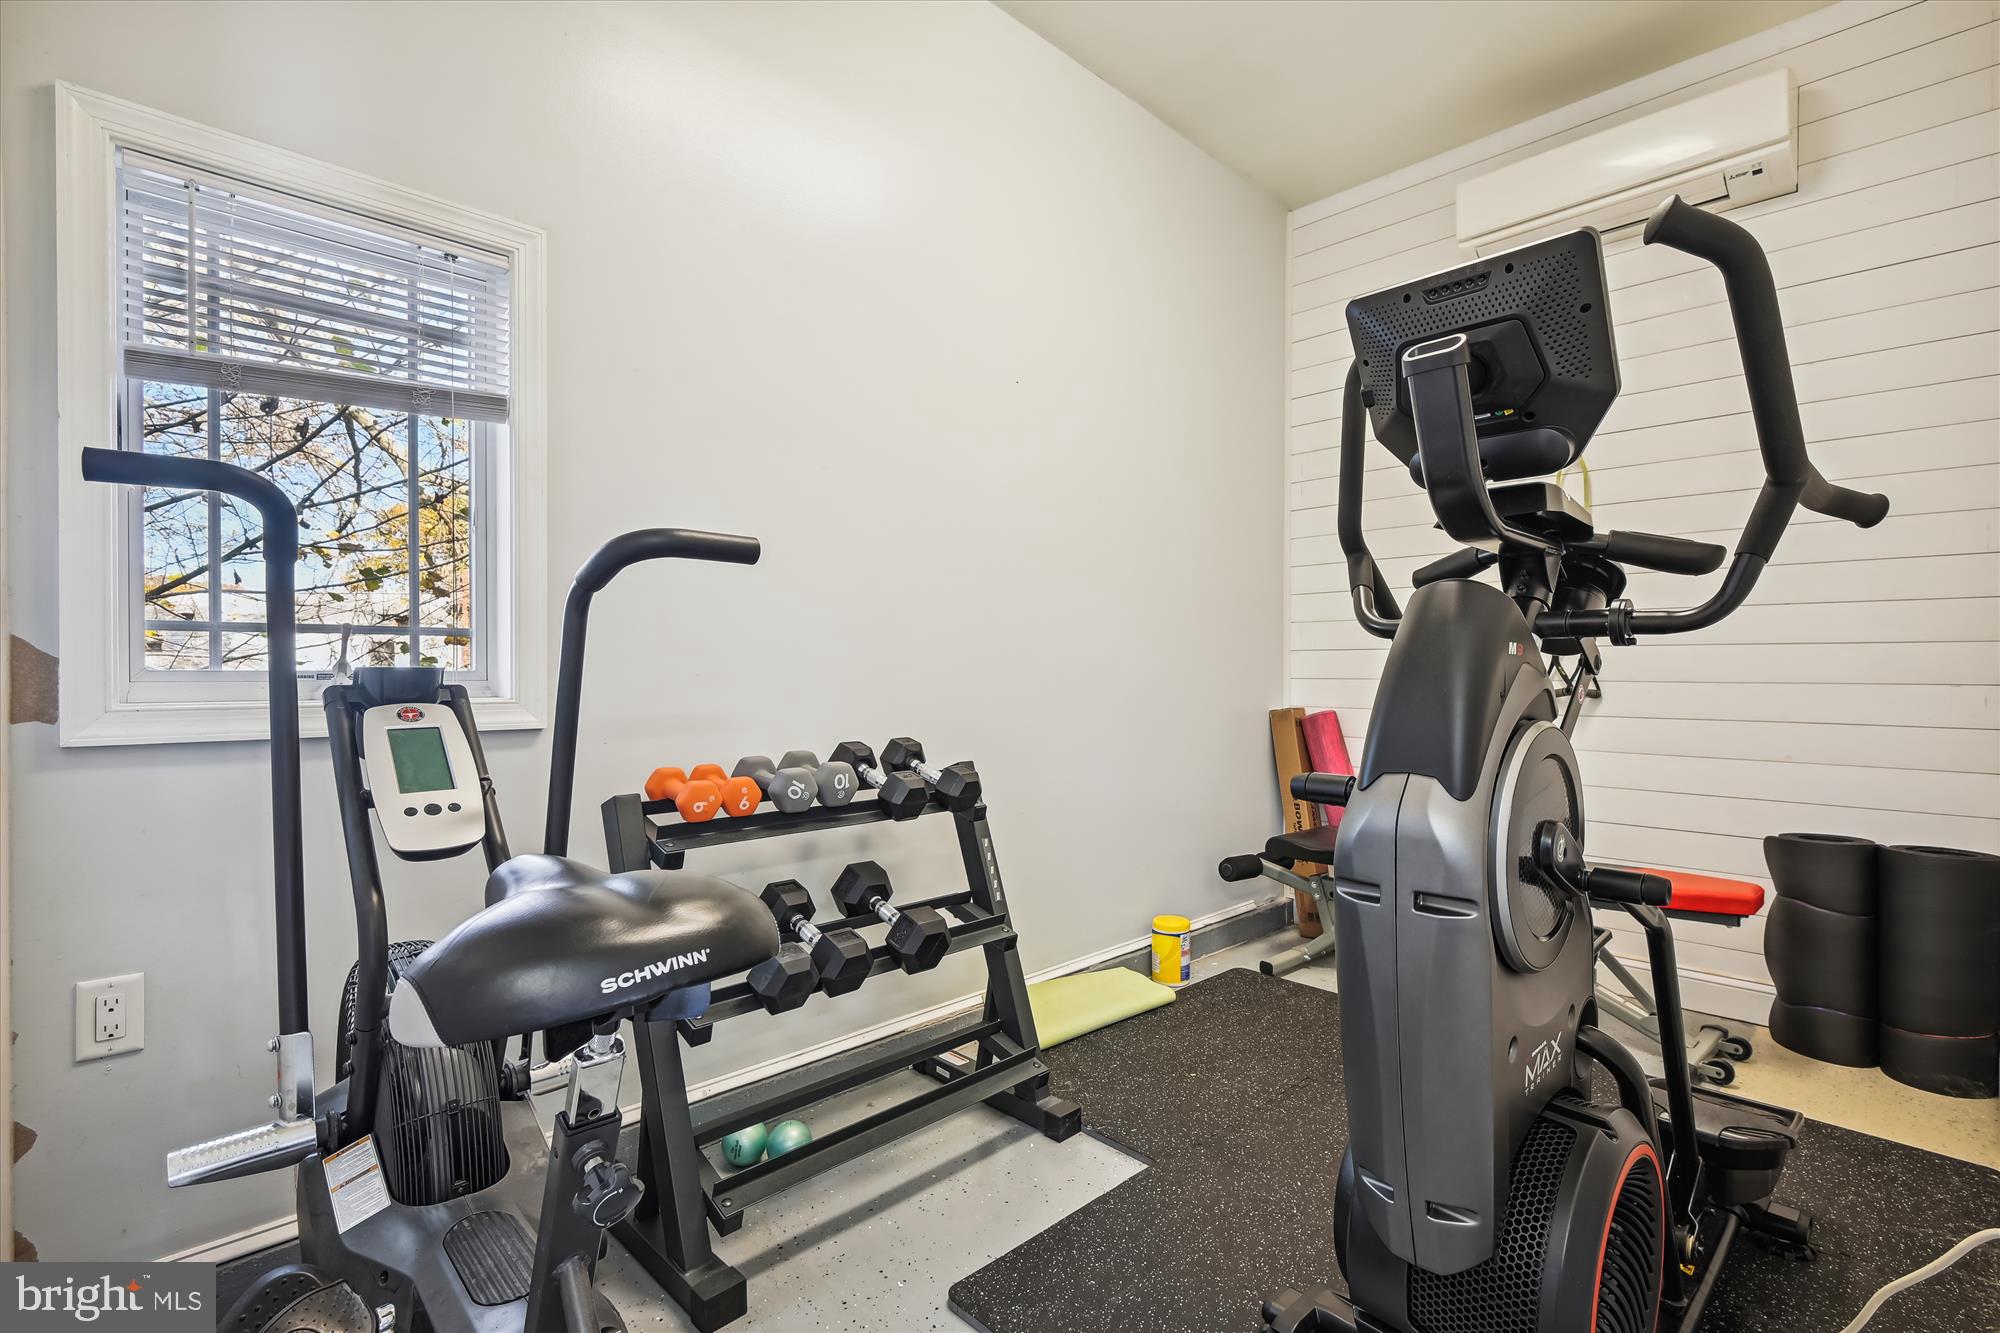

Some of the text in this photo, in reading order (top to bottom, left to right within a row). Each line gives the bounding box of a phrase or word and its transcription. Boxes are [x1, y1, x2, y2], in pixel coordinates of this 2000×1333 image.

[787, 780, 805, 800] 10
[834, 773, 850, 789] 10
[1293, 802, 1303, 831] BOW
[600, 949, 708, 994] SCHWINN
[1525, 1031, 1562, 1087] MAX
